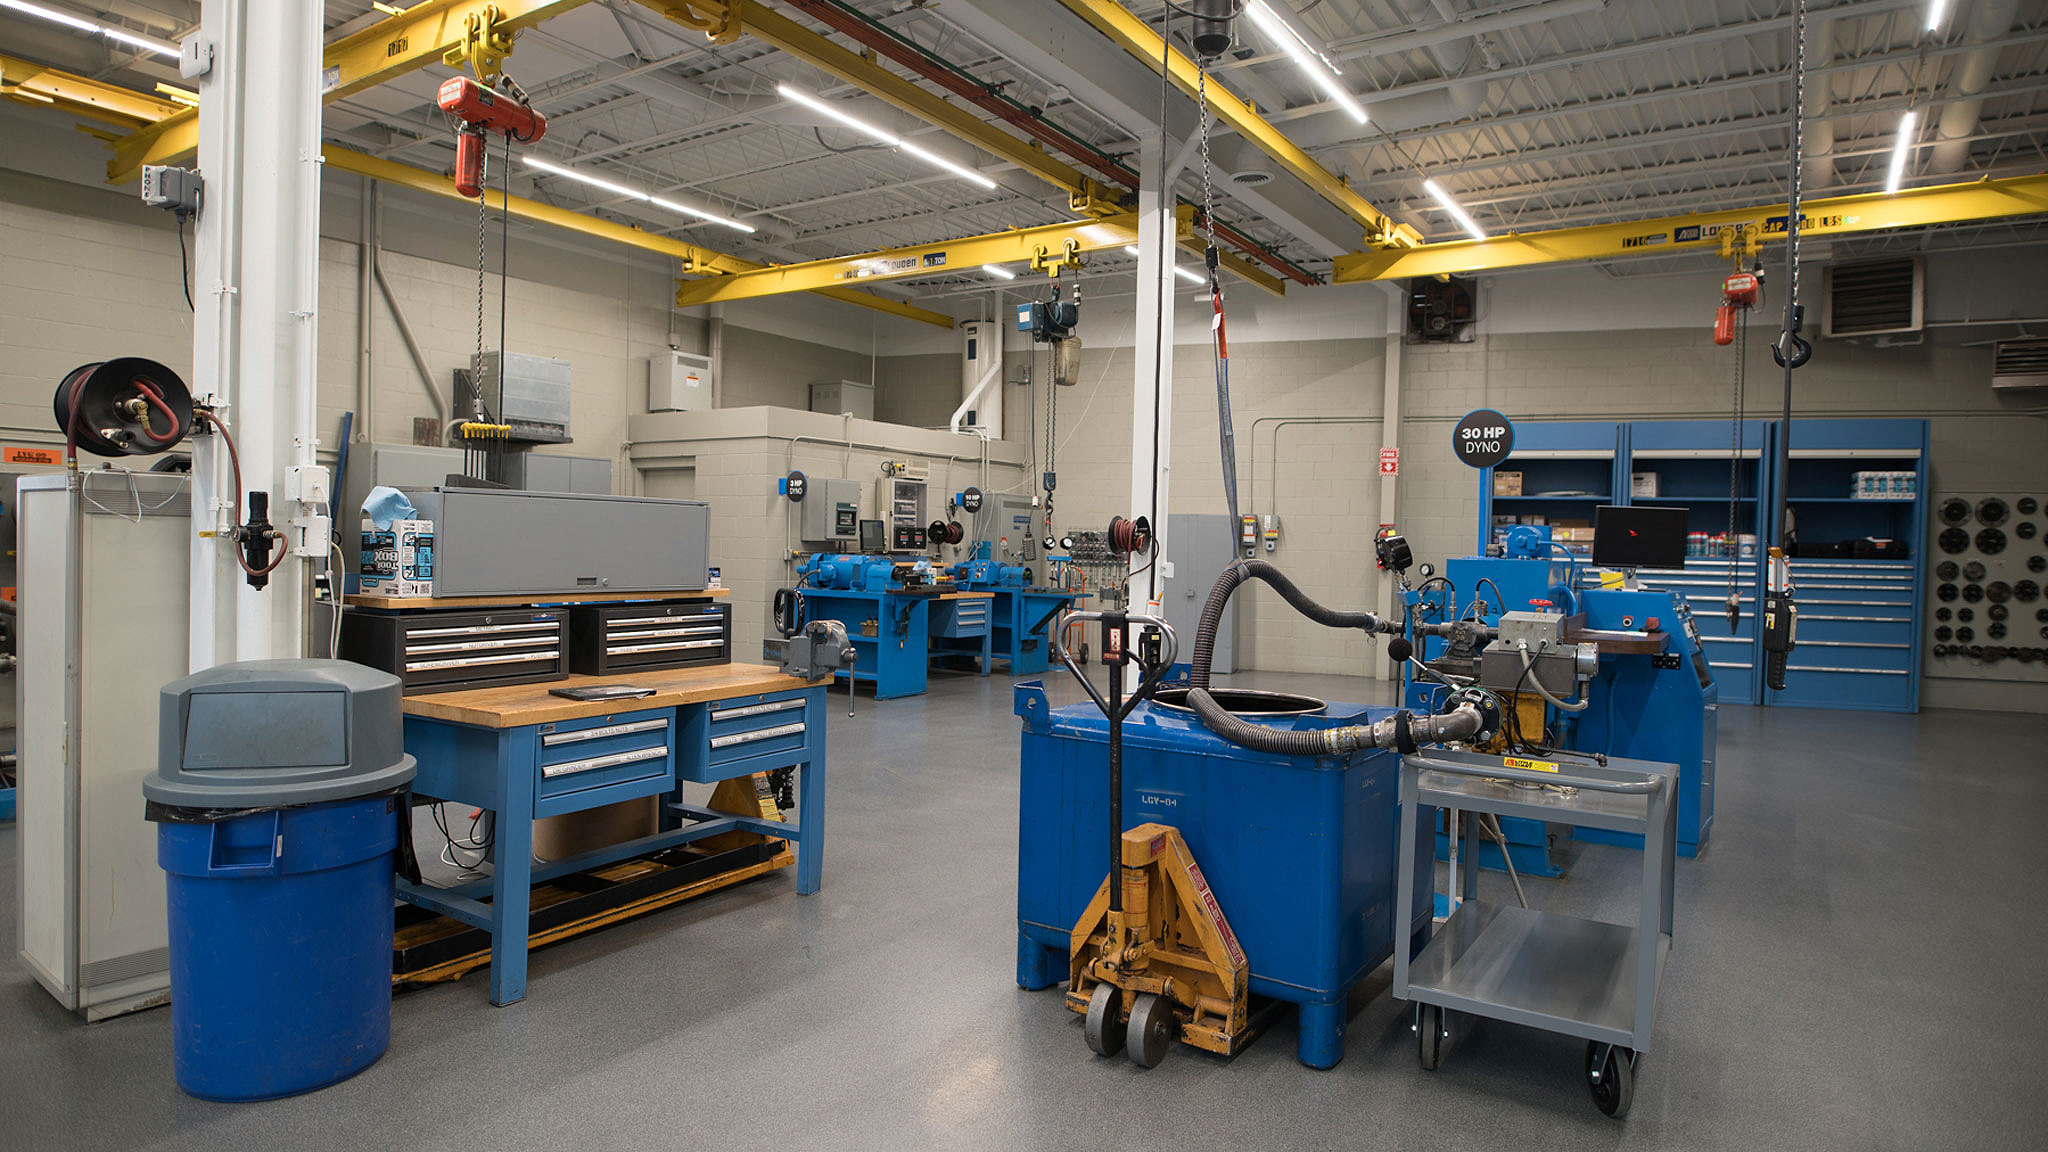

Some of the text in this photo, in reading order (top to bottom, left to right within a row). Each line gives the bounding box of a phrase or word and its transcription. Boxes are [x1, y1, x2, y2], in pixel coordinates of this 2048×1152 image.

[1761, 221, 1784, 233] CAP
[1820, 215, 1842, 228] LBS
[1461, 426, 1506, 439] 30 HP
[1465, 441, 1501, 454] DYNO
[374, 551, 398, 561] BOX
[377, 562, 398, 570] TOOL
